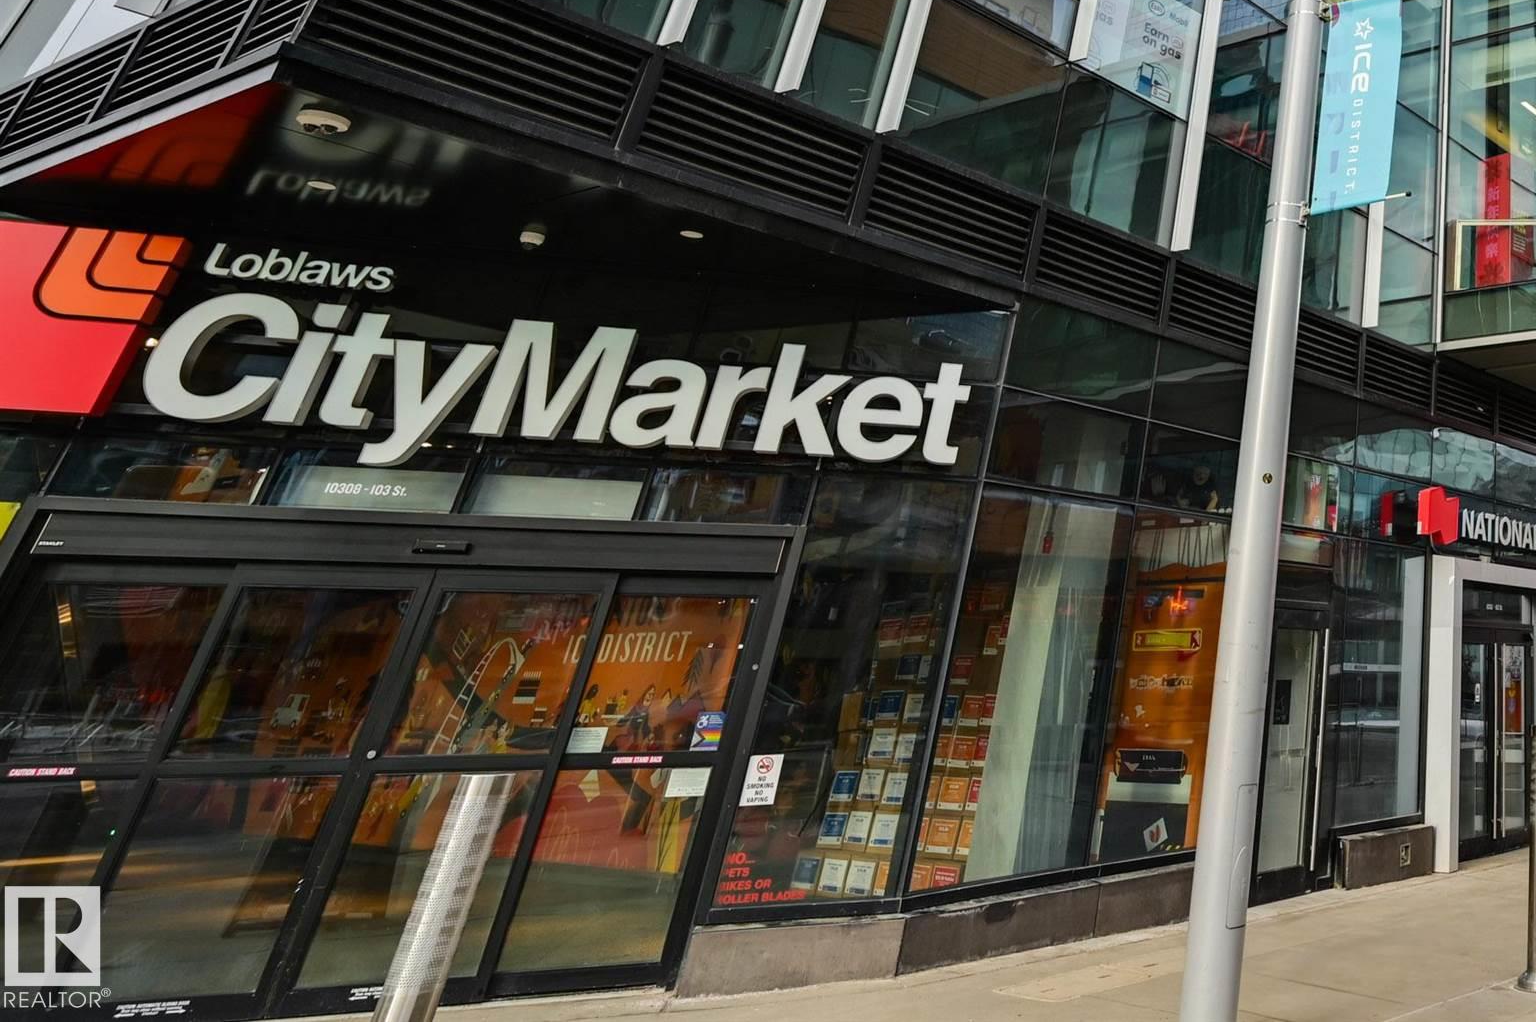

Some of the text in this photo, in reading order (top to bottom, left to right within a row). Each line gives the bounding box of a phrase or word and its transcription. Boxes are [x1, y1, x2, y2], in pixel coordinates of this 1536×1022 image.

[1144, 22, 1169, 43] Earn
[1142, 34, 1157, 48] on
[1159, 44, 1181, 60] gas
[1345, 97, 1364, 195] DISTRICT
[204, 242, 396, 292] Loblaws
[143, 292, 972, 467] CityMarket
[392, 485, 407, 496] St.
[597, 631, 692, 663] DISTRICT
[754, 878, 772, 889] OR
[761, 888, 807, 902] BLADES
